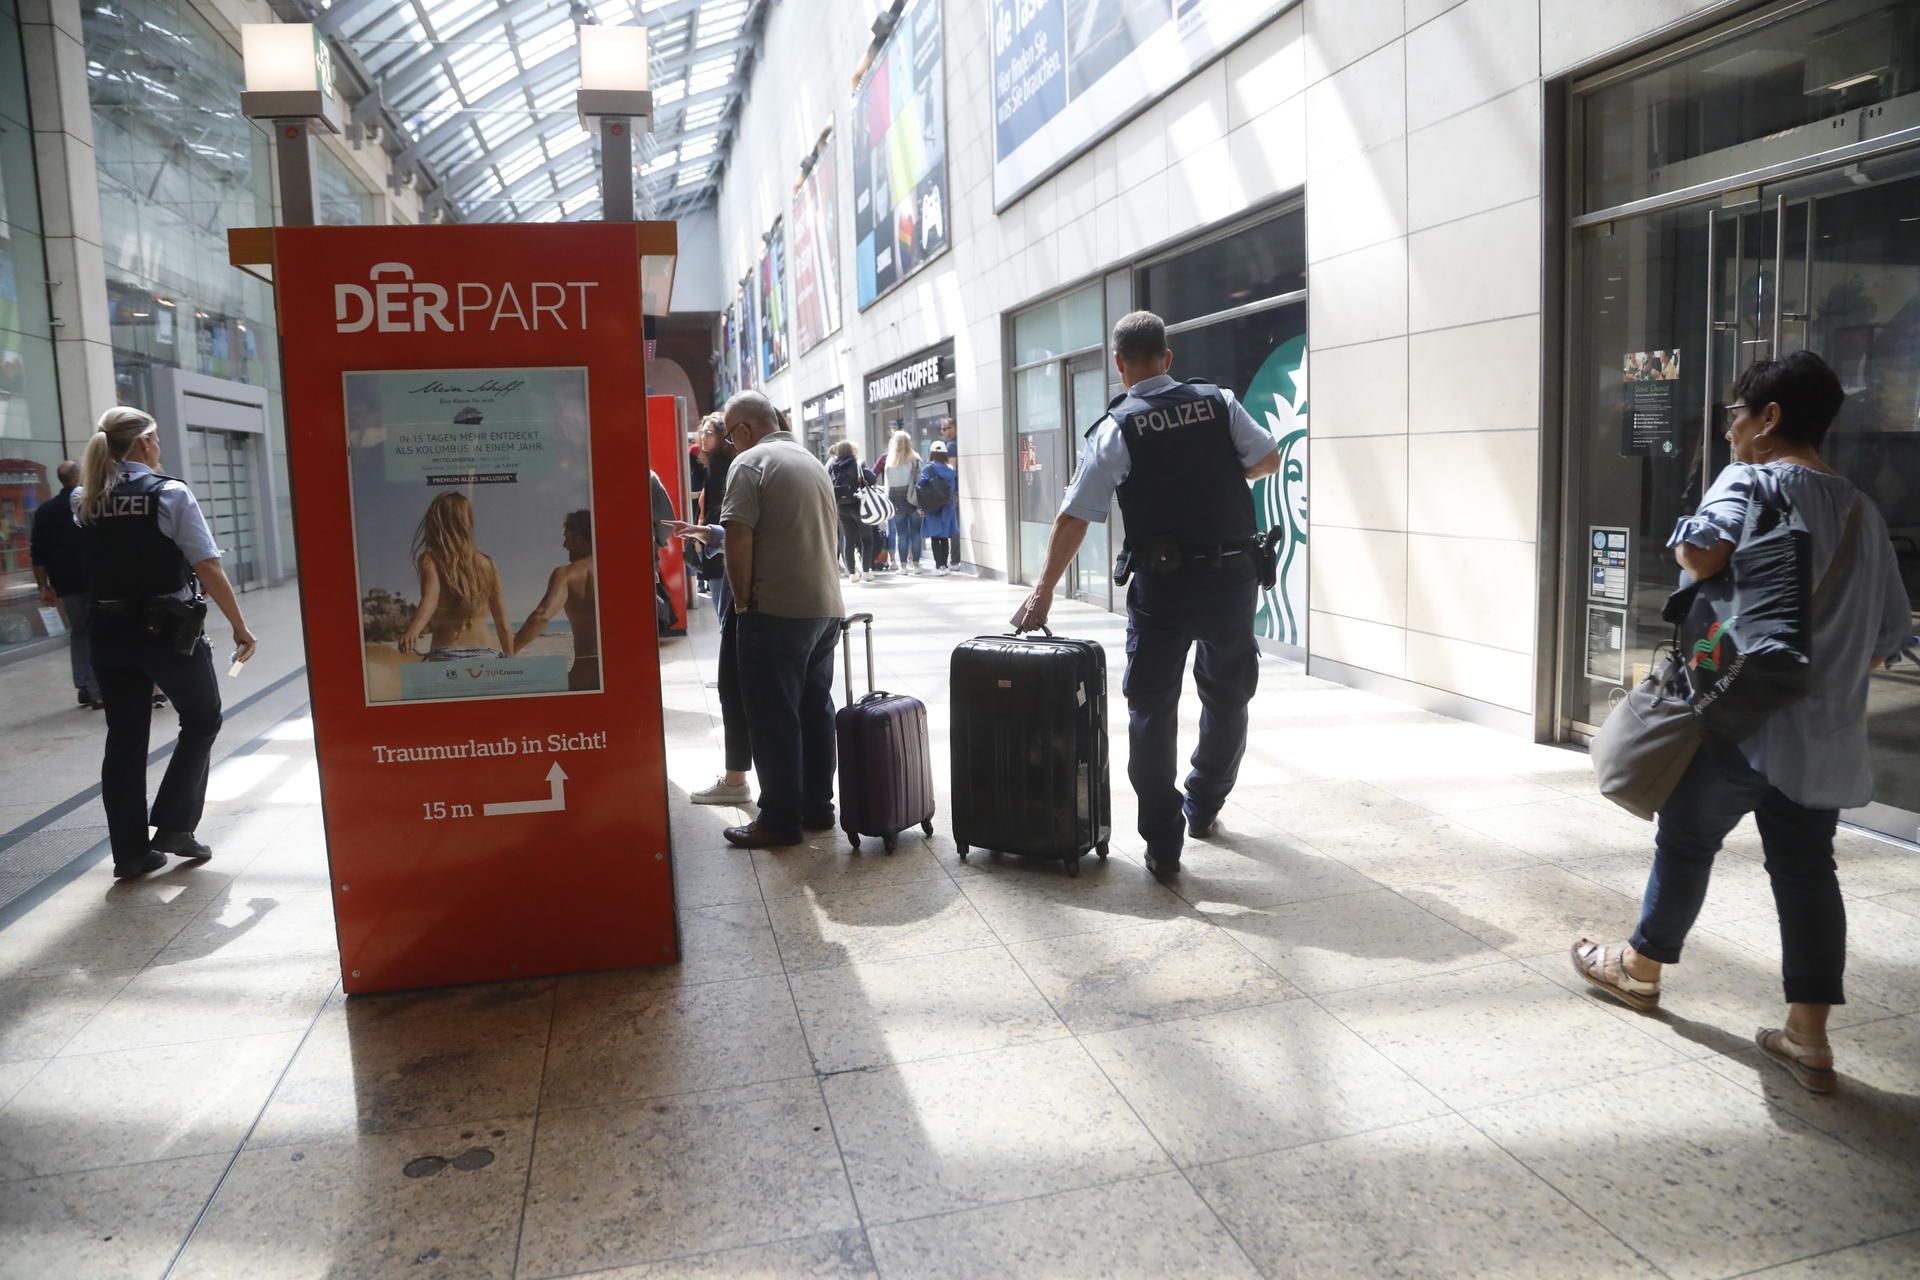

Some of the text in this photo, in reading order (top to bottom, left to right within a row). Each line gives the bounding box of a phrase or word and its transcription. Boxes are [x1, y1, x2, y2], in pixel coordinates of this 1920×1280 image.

[409, 380, 463, 394] Mein
[868, 356, 939, 402] STARBUCKS COFFEE
[1134, 399, 1216, 436] POLIZEI
[413, 434, 423, 443] 15
[427, 433, 456, 442] TAGEN
[460, 432, 487, 441] MEHR
[490, 431, 539, 441] ENTDECKT
[395, 447, 413, 455] ALS
[416, 445, 469, 454] KOLUMBUS
[486, 443, 514, 452] EINEM
[91, 495, 149, 518] OLIZEI
[373, 731, 607, 763] Traumurlaub in Sicht!
[423, 802, 474, 820] 15 m
